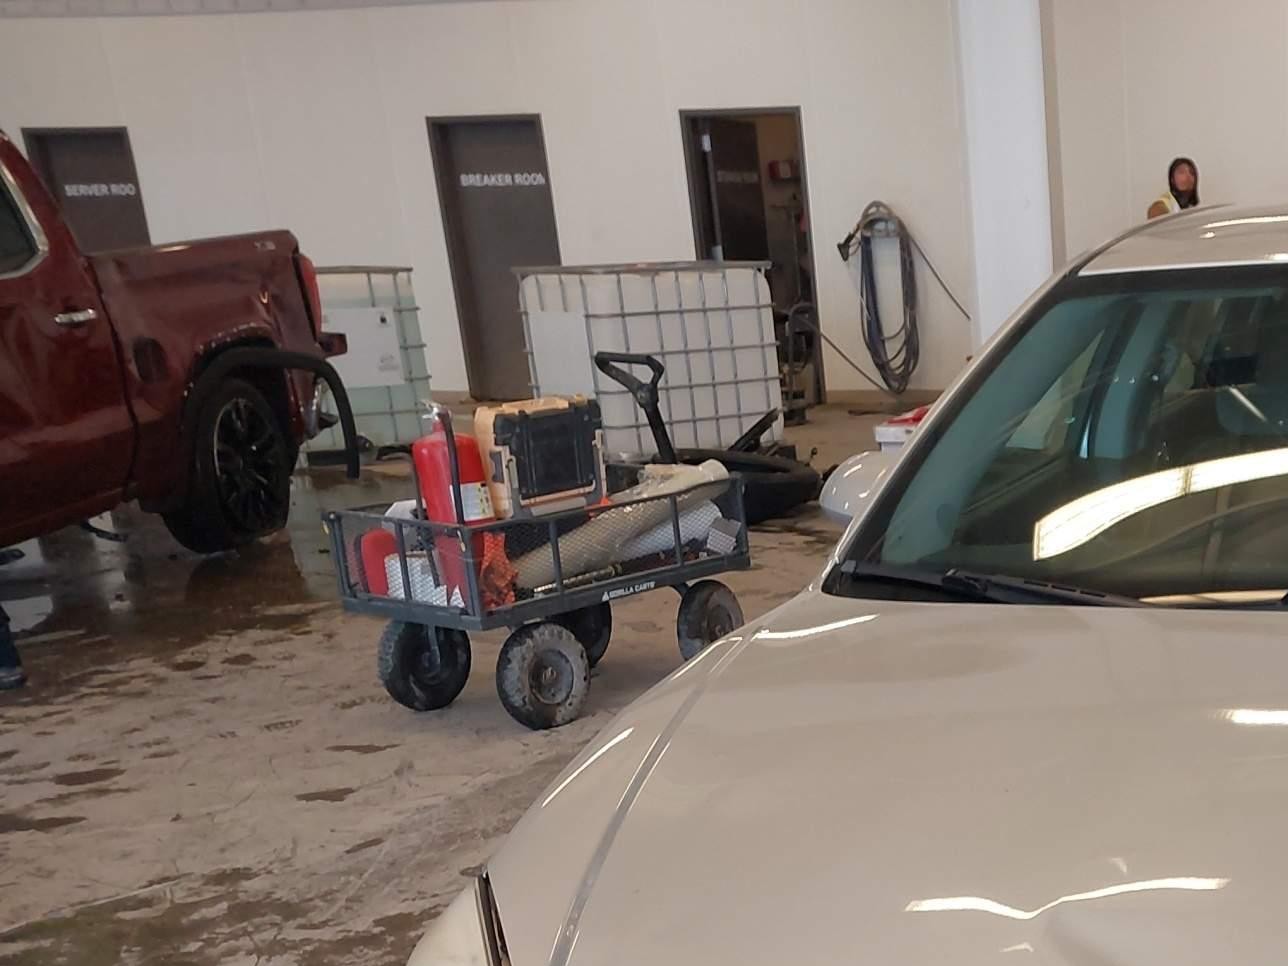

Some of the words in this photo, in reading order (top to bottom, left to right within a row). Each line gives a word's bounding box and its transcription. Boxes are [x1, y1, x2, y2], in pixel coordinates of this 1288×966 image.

[460, 173, 513, 187] BREAKER
[65, 184, 109, 197] SERVER
[110, 183, 136, 196] ROO
